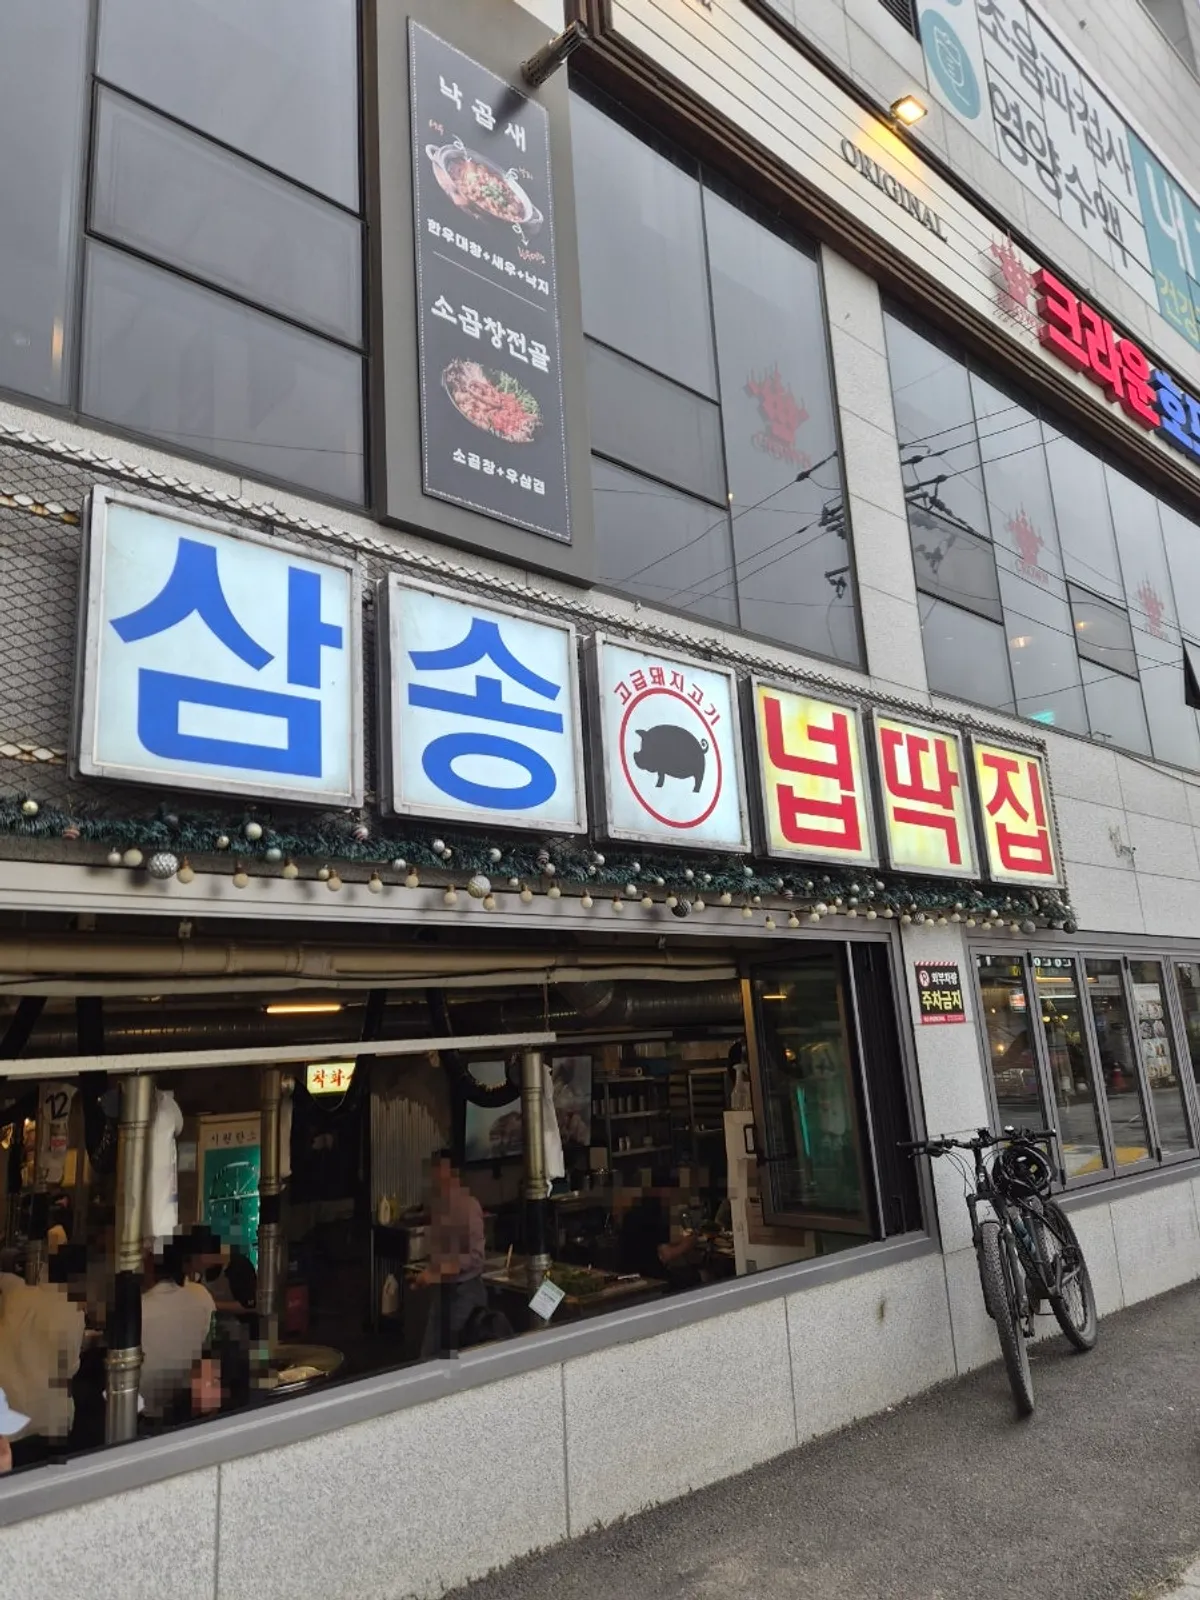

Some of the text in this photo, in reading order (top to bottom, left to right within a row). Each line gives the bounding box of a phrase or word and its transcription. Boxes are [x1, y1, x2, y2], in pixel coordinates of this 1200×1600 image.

[839, 137, 949, 243] ORIGINAL
[988, 82, 1128, 268] 영양수액
[431, 294, 550, 374] 소곱창전골
[110, 537, 1054, 876] 삼송 넙딱집
[613, 666, 721, 727] 고급돼지고기
[921, 989, 963, 1011] 주차금지
[46, 1092, 69, 1118] 12
[312, 1067, 353, 1088] 착화
